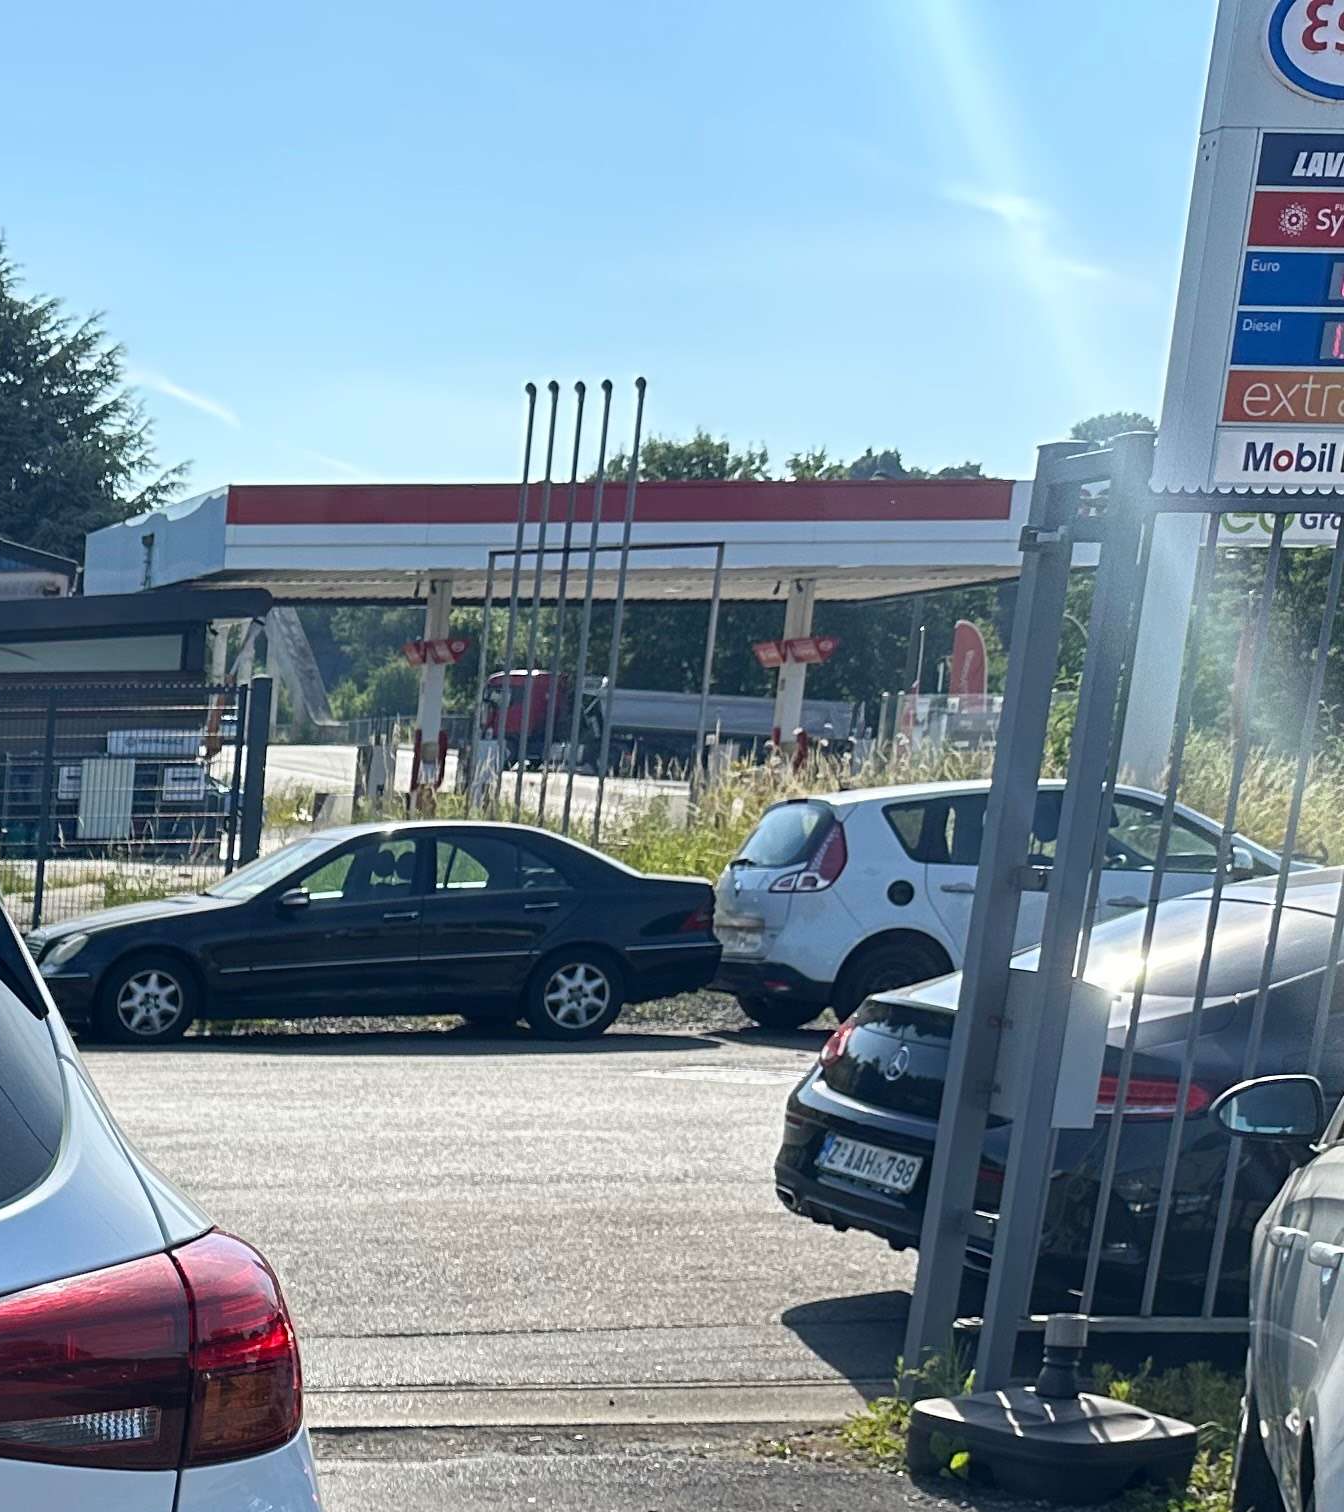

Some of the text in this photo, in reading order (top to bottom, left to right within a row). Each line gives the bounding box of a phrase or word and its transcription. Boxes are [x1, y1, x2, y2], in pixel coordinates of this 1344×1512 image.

[1292, 151, 1344, 177] LAV
[1251, 259, 1280, 272] Euro
[1242, 318, 1281, 332] Diesel
[1242, 441, 1336, 473] Mobil
